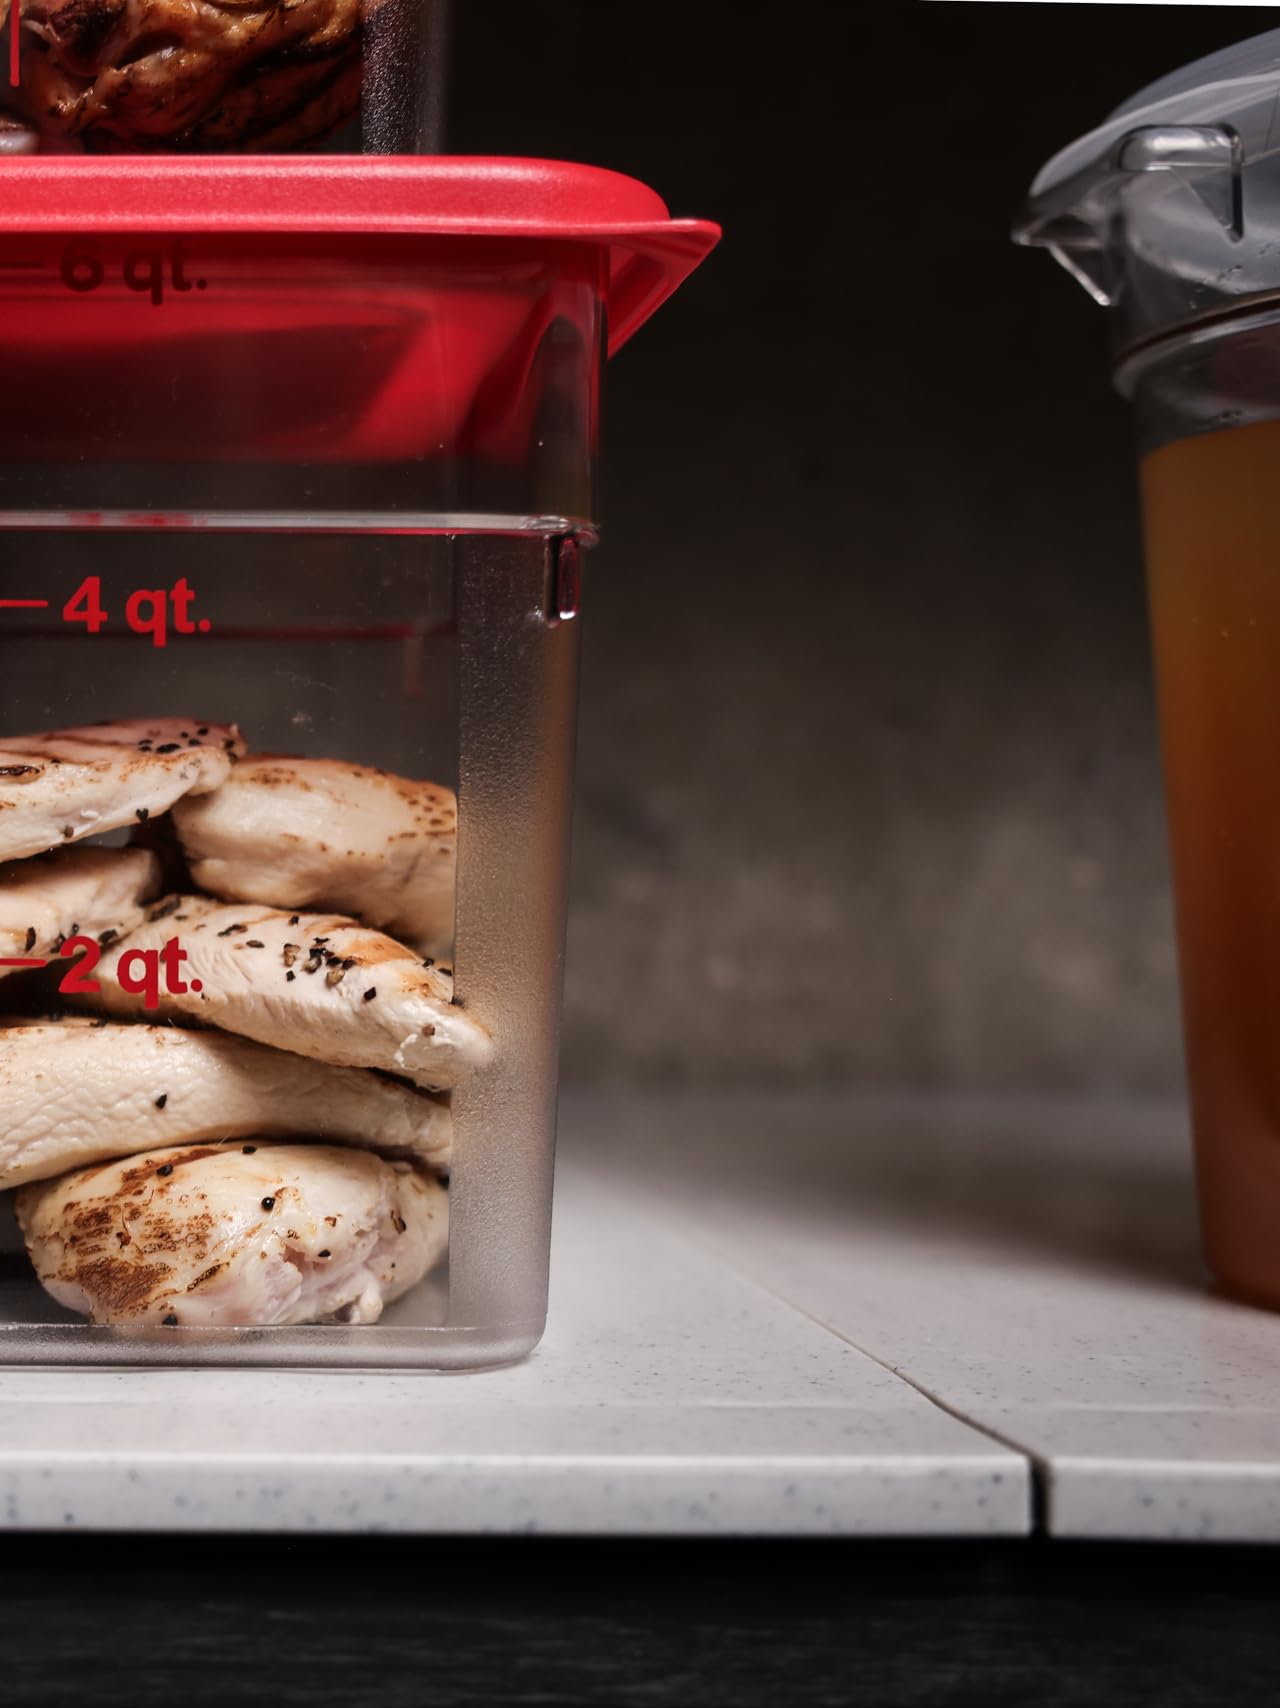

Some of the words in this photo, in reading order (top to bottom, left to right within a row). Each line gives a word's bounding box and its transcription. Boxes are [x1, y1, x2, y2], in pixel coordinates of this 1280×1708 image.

[59, 238, 105, 292] 6
[122, 239, 208, 306] qt.
[62, 576, 108, 633] 4
[125, 577, 212, 648] qt.
[58, 935, 102, 994] 2
[116, 935, 204, 1009] qt.
